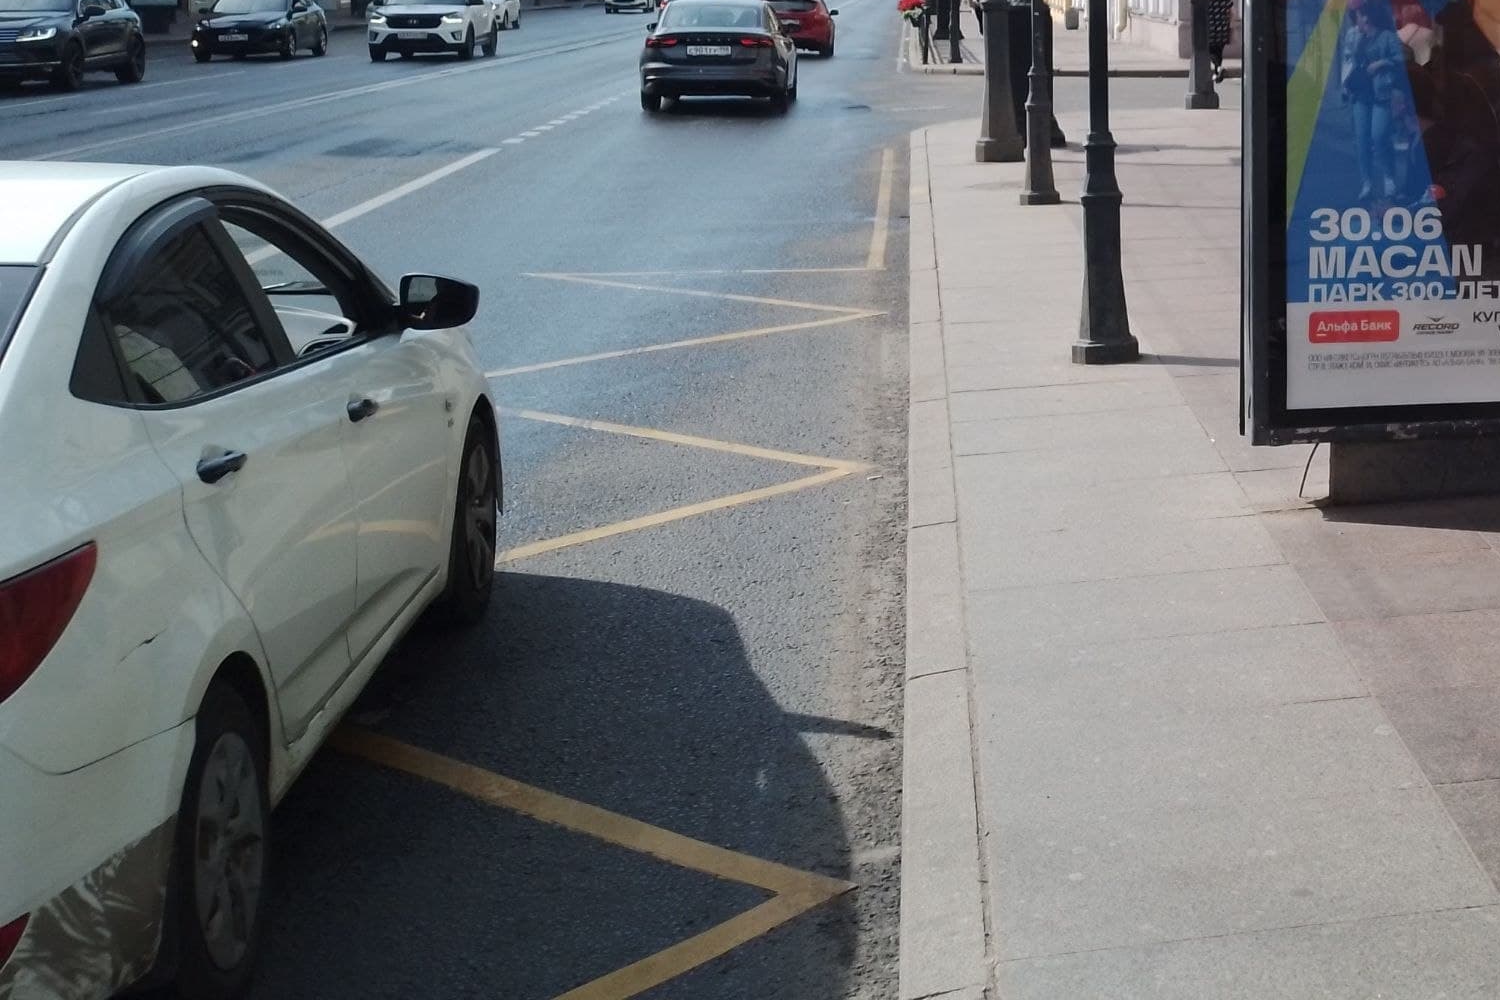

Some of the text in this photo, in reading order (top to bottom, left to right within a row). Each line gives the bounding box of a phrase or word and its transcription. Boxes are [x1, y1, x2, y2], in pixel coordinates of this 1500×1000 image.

[1308, 206, 1443, 241] 30.06
[1308, 243, 1483, 279] MACAN
[1307, 283, 1384, 303] ПАРК
[1315, 319, 1393, 335] Альфа Банк
[1412, 322, 1460, 331] RECORD
